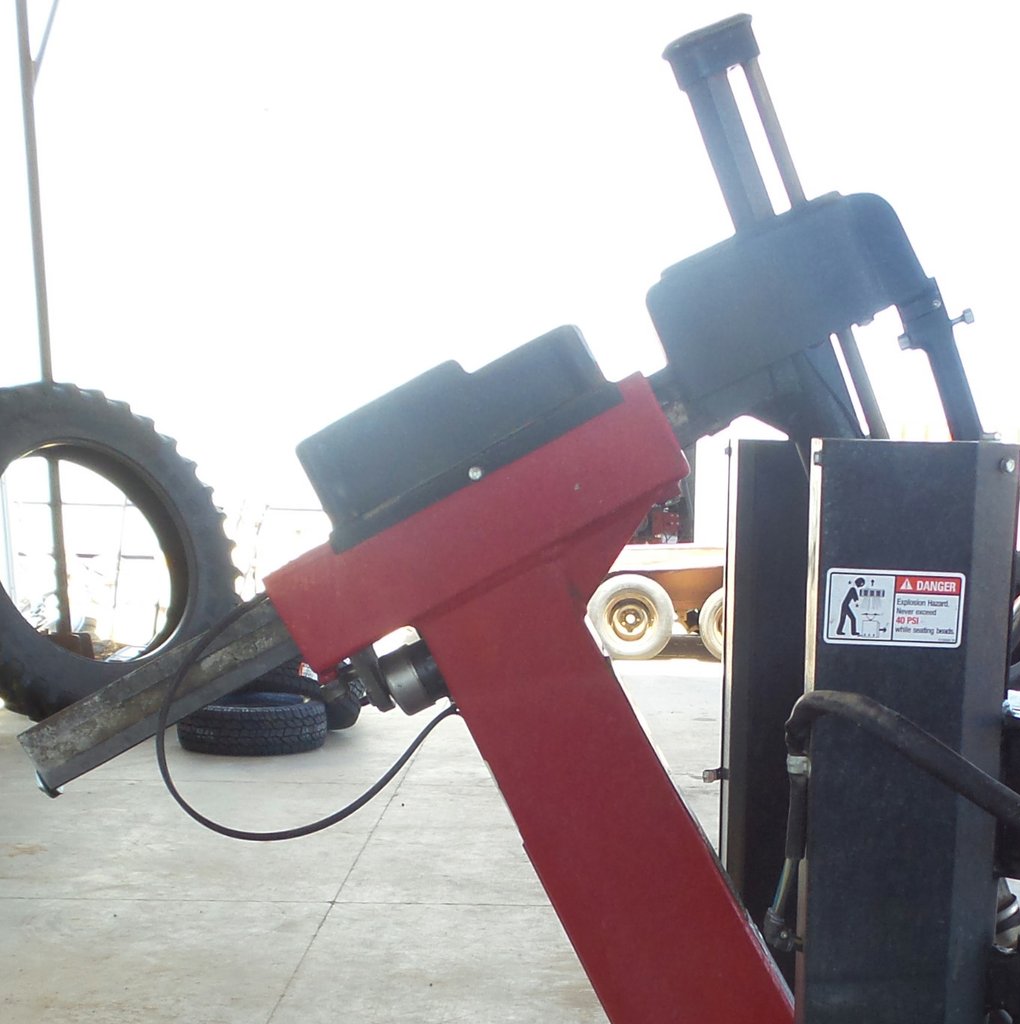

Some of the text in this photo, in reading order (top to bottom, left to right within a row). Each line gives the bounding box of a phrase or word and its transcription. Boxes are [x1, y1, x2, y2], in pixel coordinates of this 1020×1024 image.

[916, 580, 957, 592] DANGER
[897, 598, 926, 606] Explosion
[896, 607, 914, 615] Never
[896, 616, 919, 625] 40 PSI
[913, 628, 934, 636] seating
